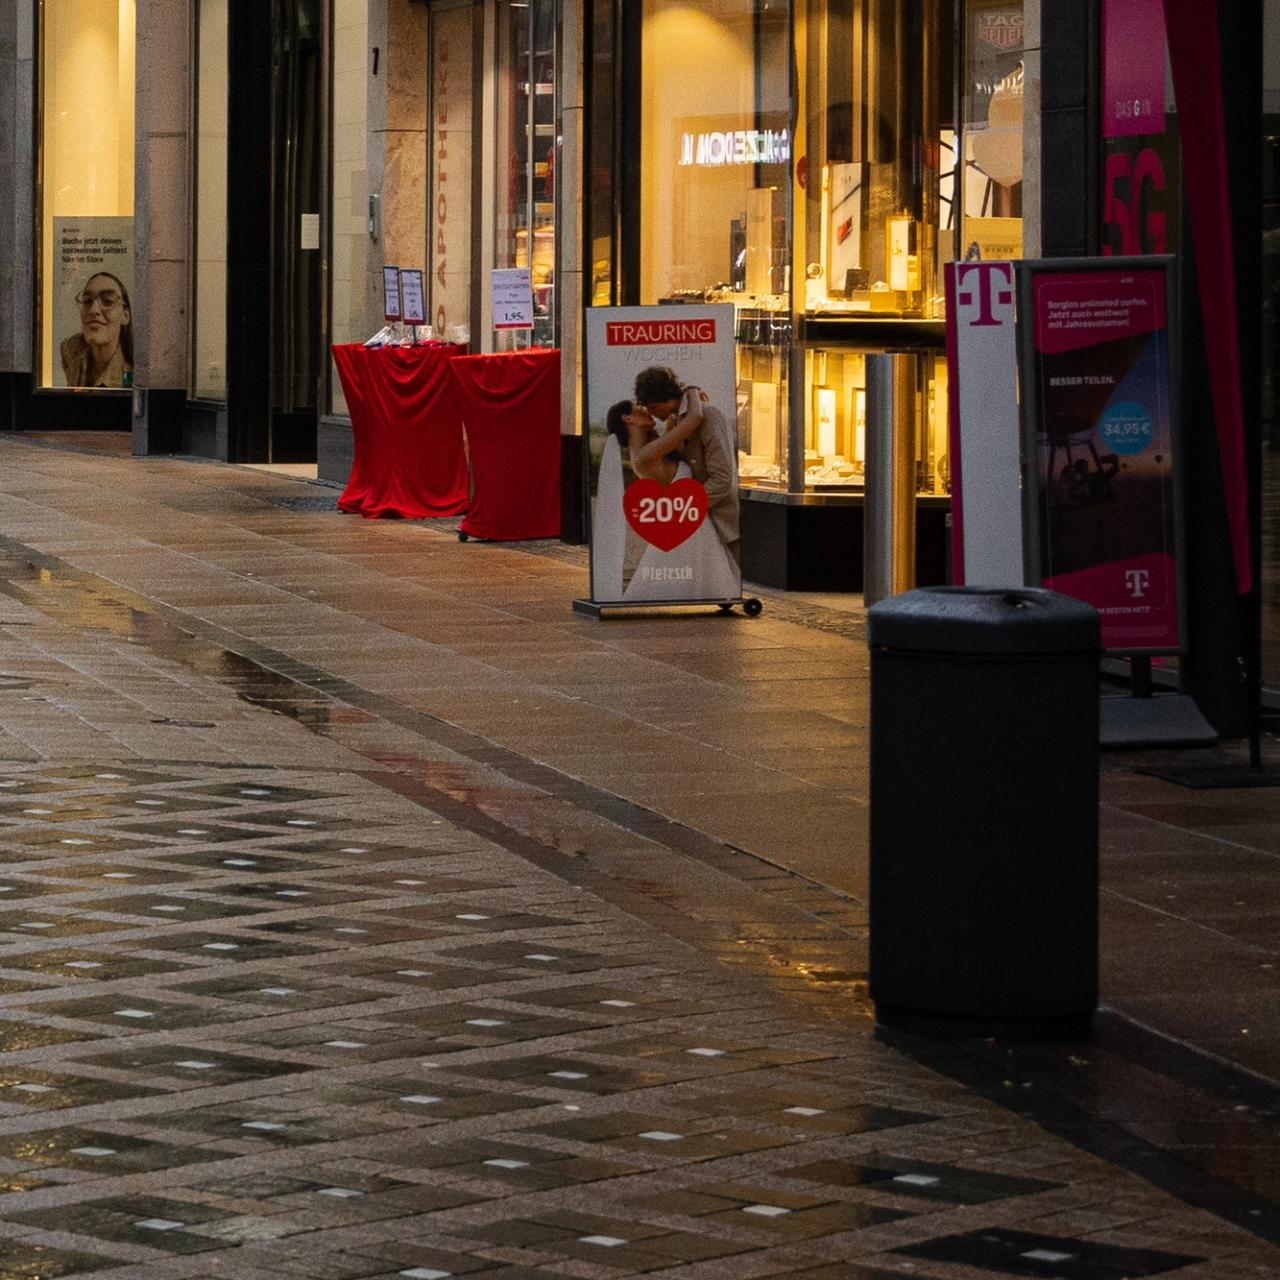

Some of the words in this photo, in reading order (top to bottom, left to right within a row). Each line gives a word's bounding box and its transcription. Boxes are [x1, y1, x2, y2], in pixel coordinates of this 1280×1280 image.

[1134, 99, 1140, 116] G
[436, 39, 447, 288] APOTHEKE
[1103, 148, 1167, 256] 5G
[609, 323, 712, 342] TRAURING
[624, 347, 702, 362] WOCHEN
[1050, 377, 1081, 386] BESSER
[1084, 376, 1115, 385] TEILEN.
[641, 566, 692, 581] Pletzsch
